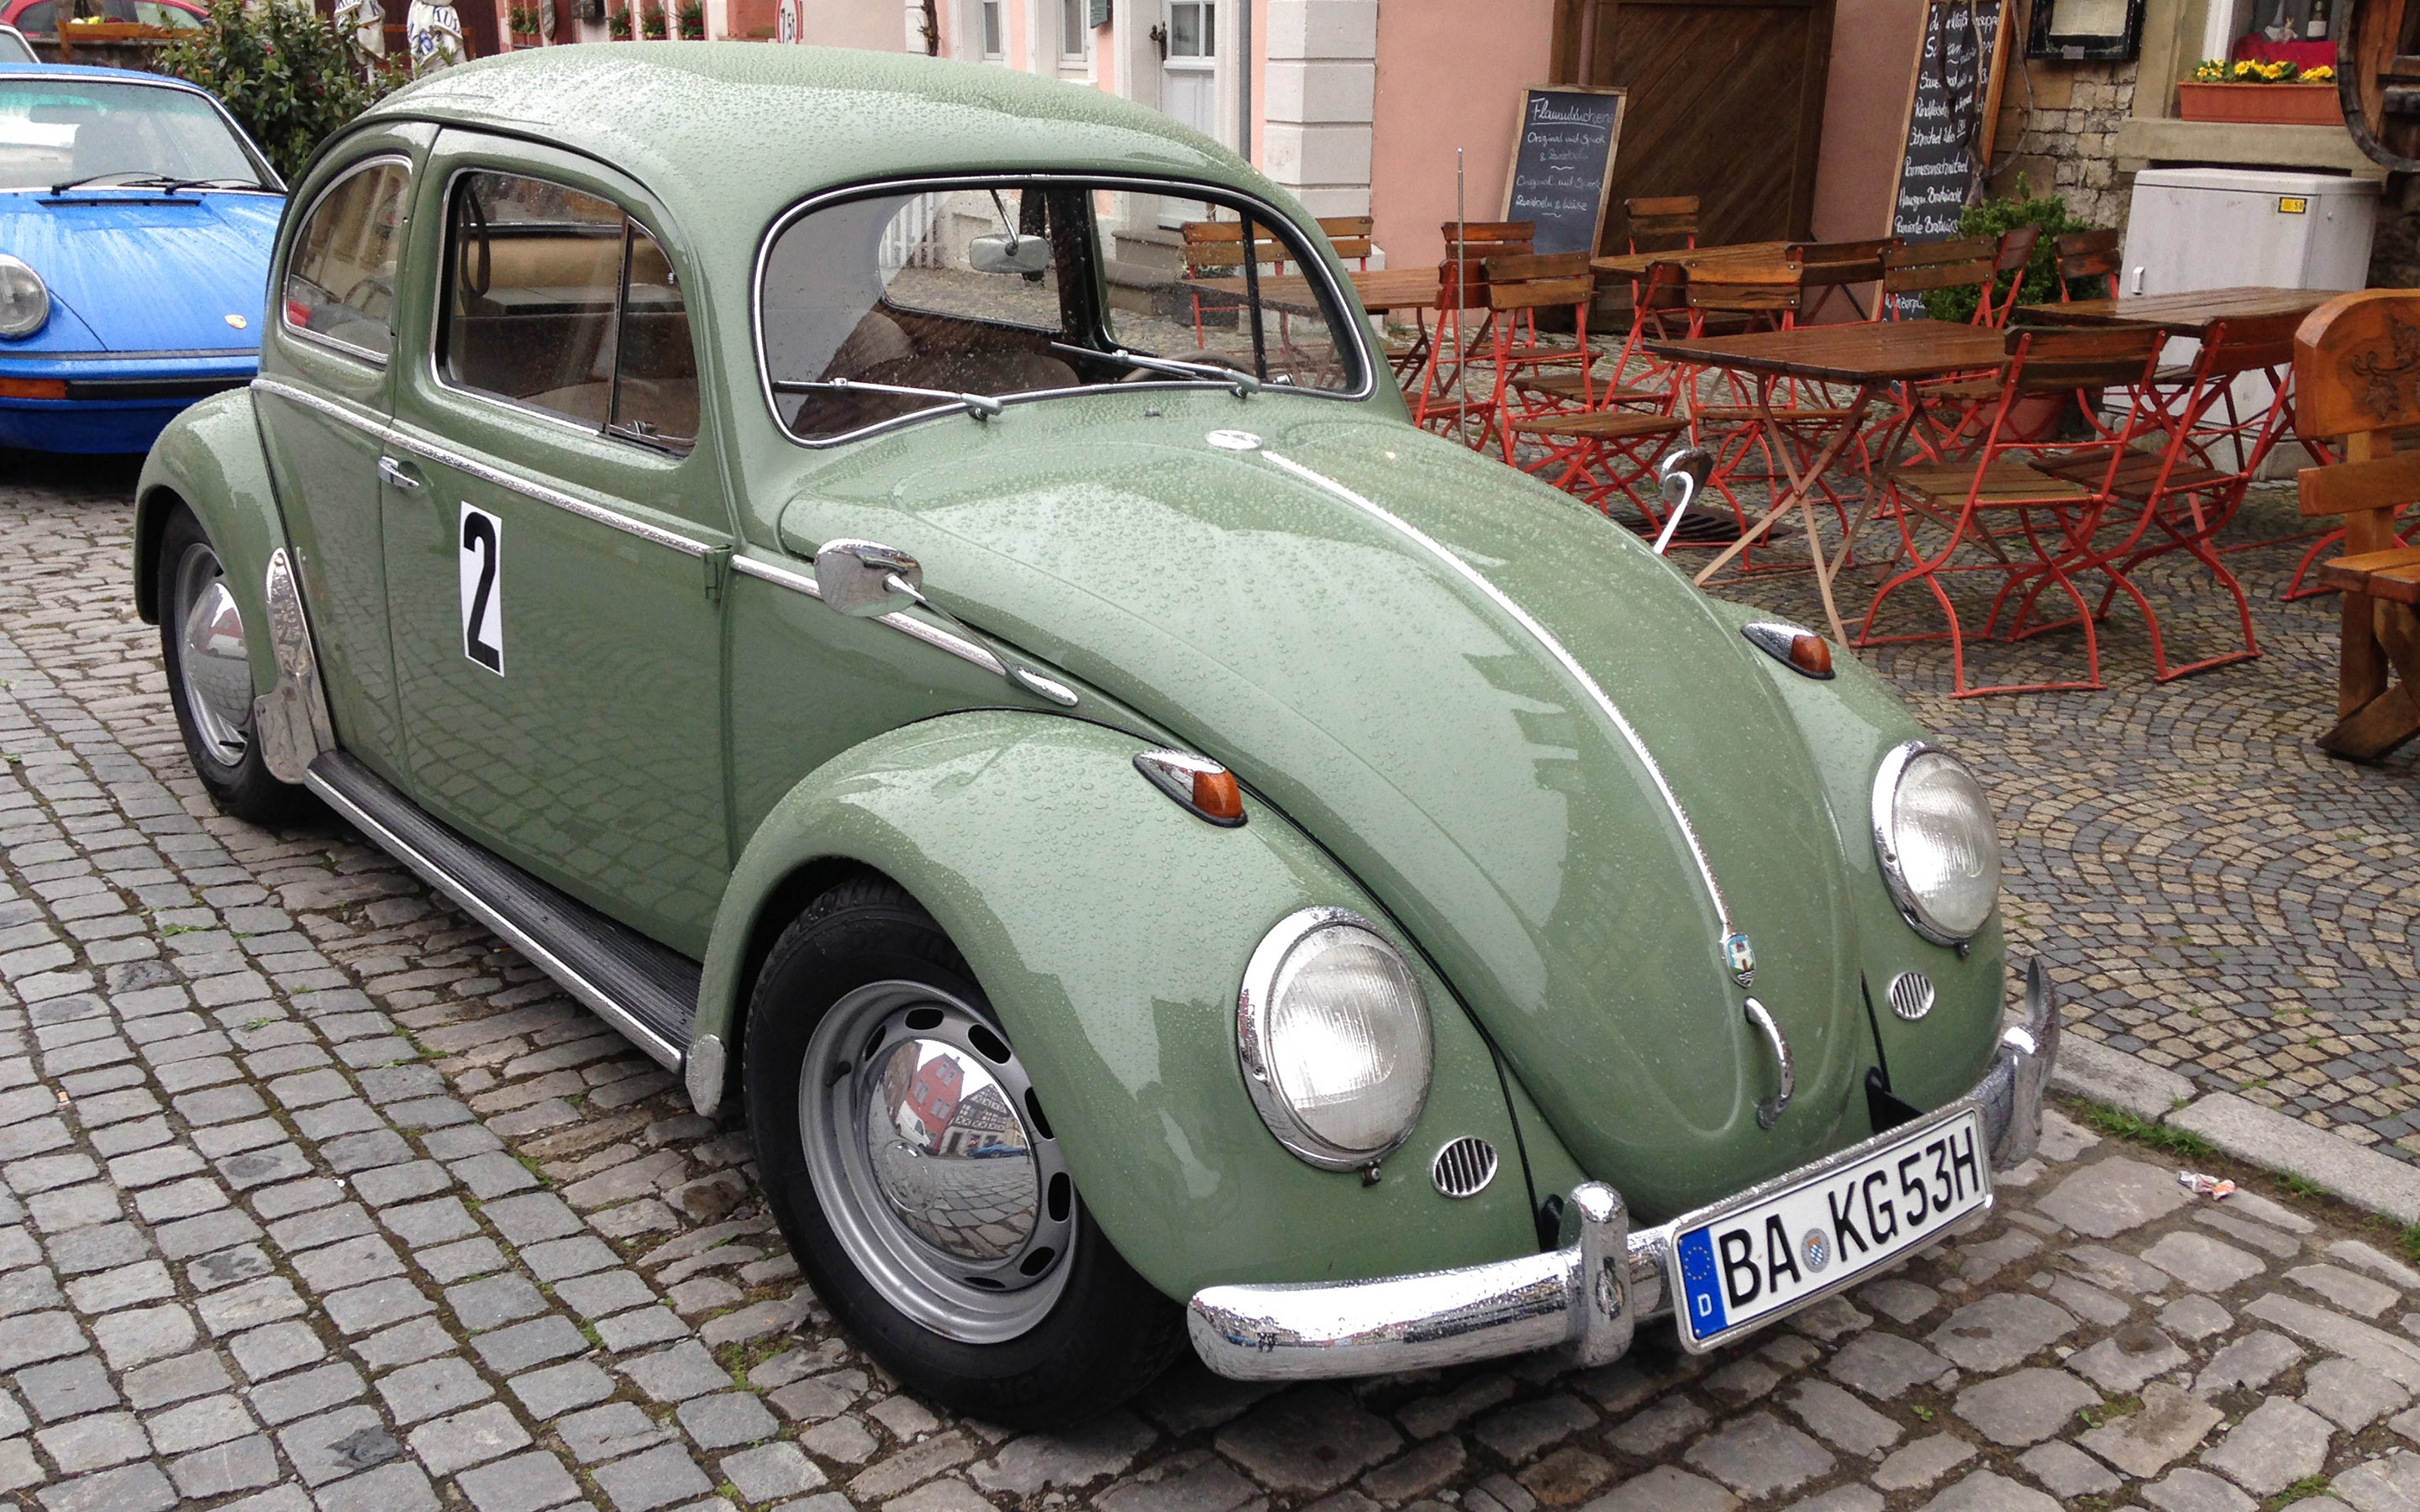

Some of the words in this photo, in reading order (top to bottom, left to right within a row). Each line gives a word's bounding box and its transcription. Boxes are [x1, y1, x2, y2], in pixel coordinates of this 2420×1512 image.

[463, 511, 501, 674] 2
[1697, 1293, 1712, 1317] D
[1718, 1213, 1802, 1310] BA
